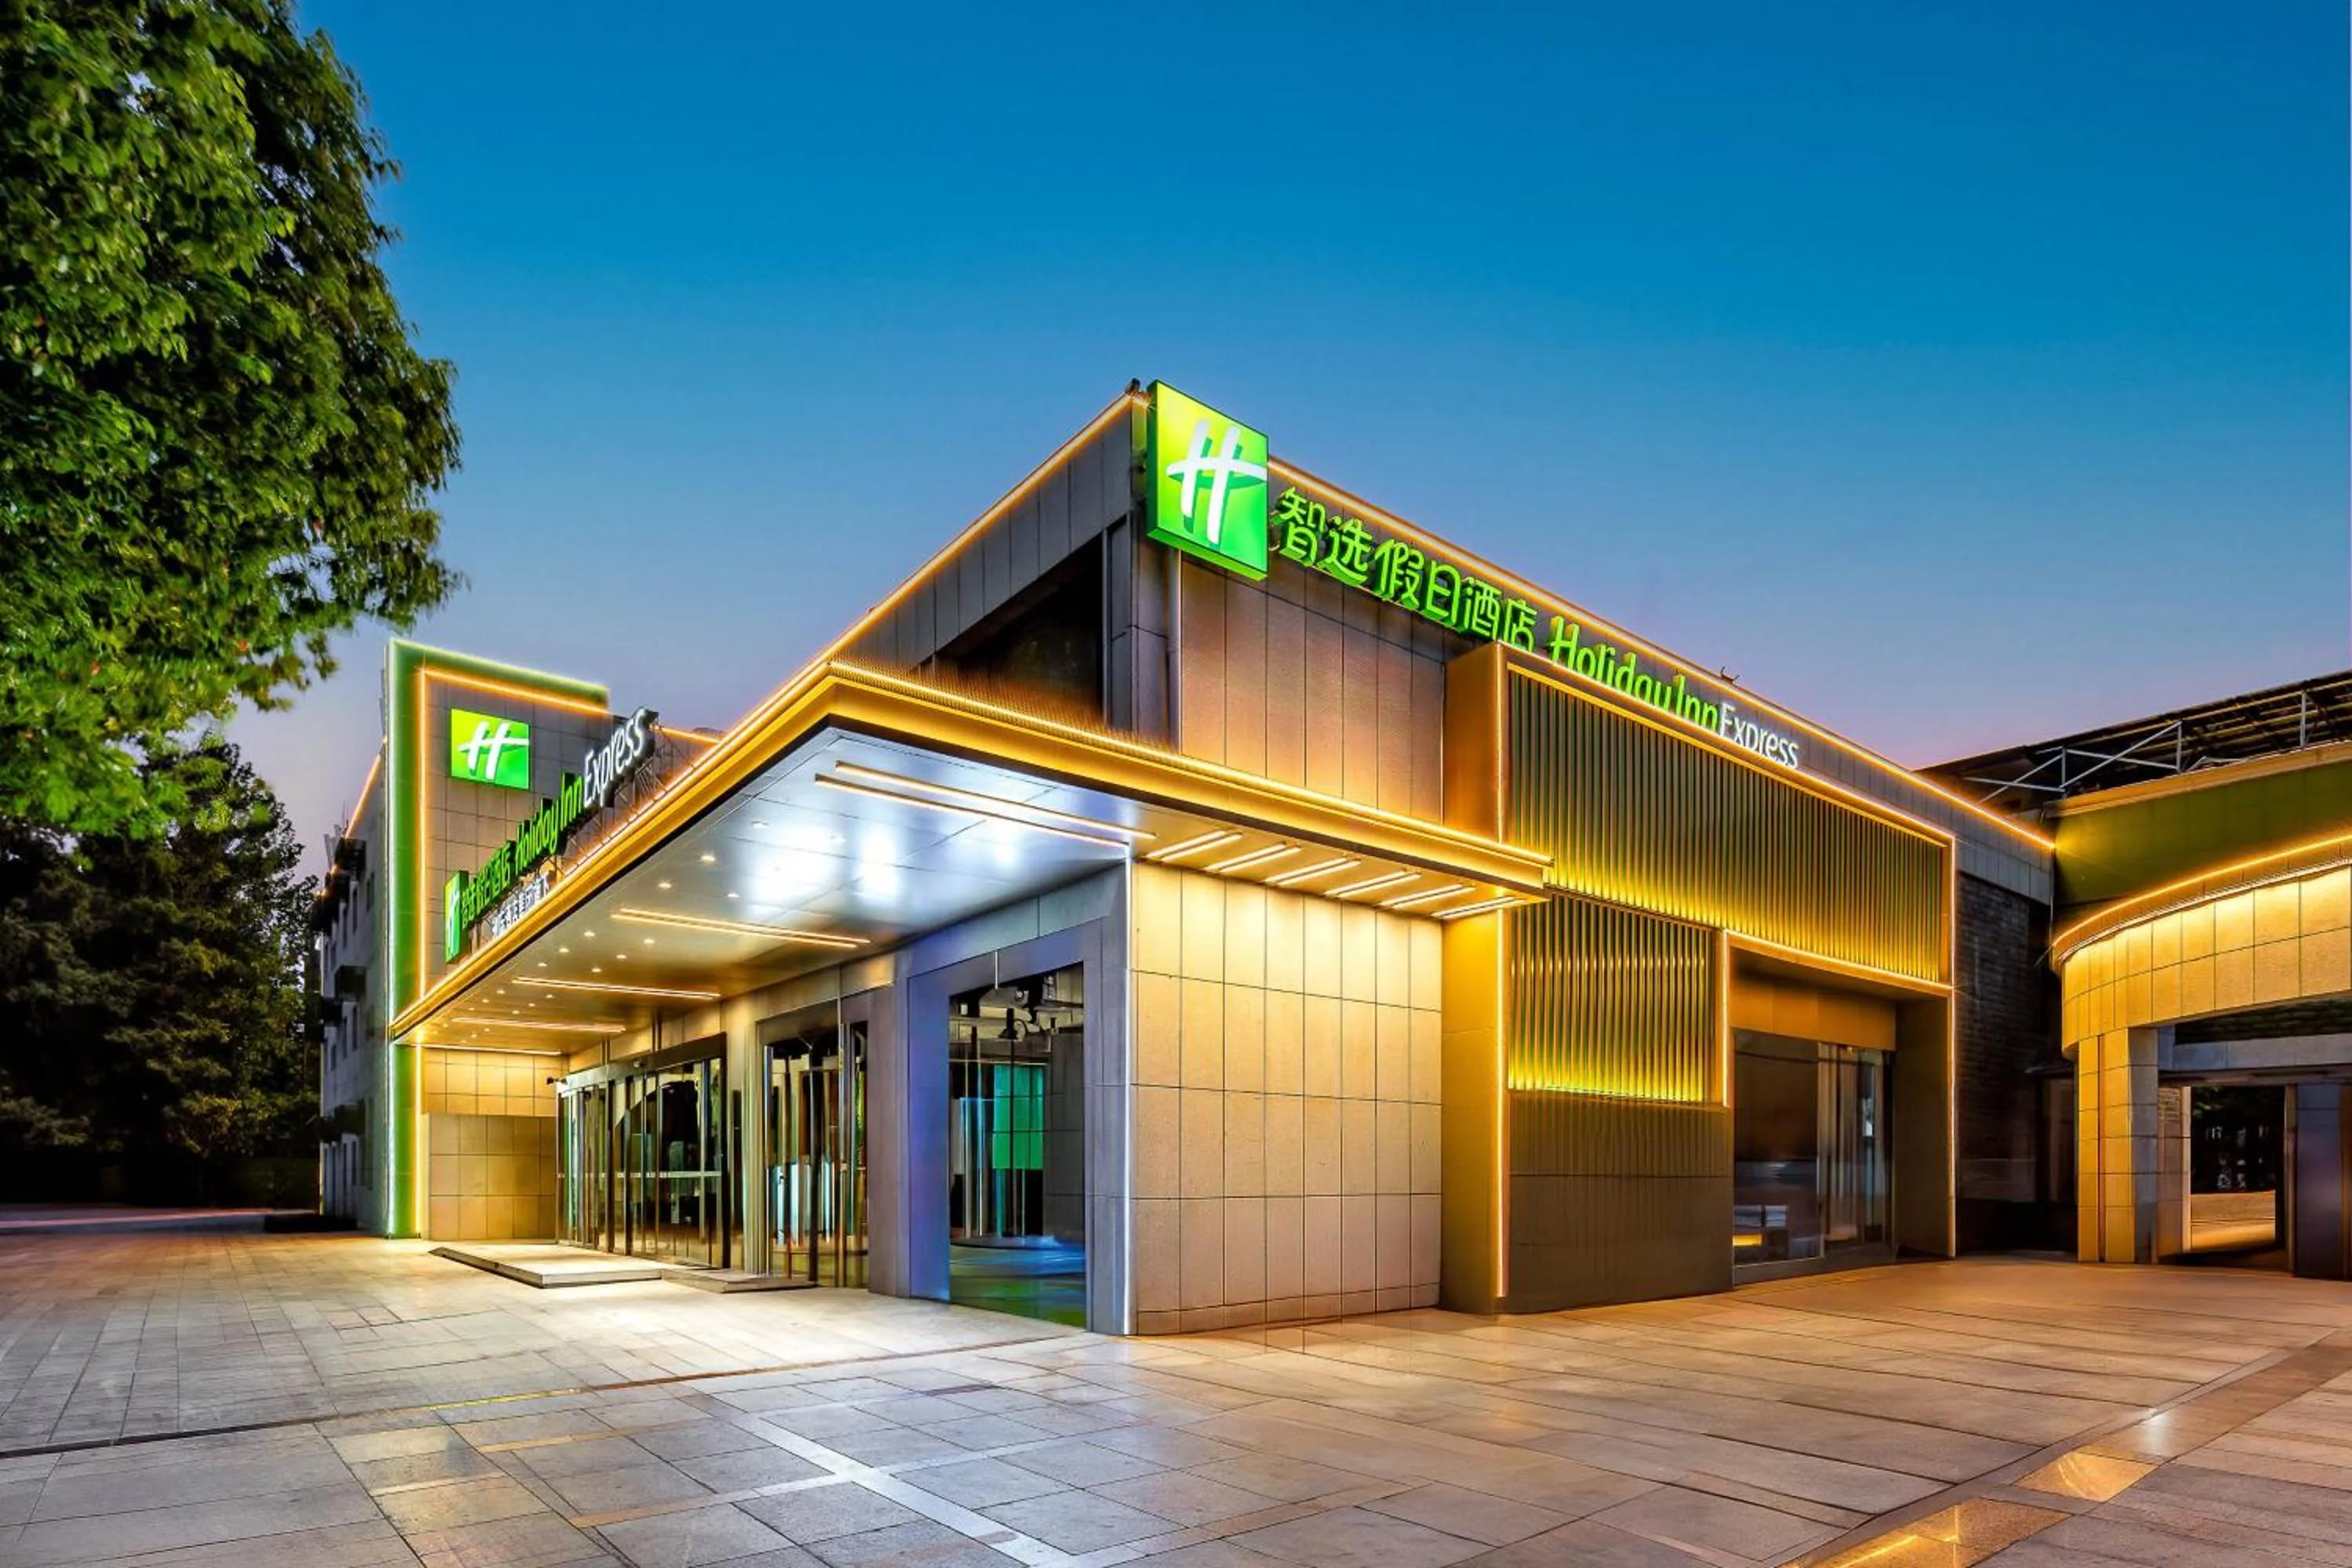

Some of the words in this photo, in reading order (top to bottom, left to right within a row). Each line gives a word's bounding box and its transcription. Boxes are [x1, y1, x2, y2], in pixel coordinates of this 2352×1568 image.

[1273, 485, 1538, 653] 智选假日酒店
[1674, 673, 1719, 732] Inn
[1719, 702, 1801, 770] Express
[515, 797, 560, 877] Holiday
[560, 771, 584, 831] Inn
[583, 707, 648, 809] Express
